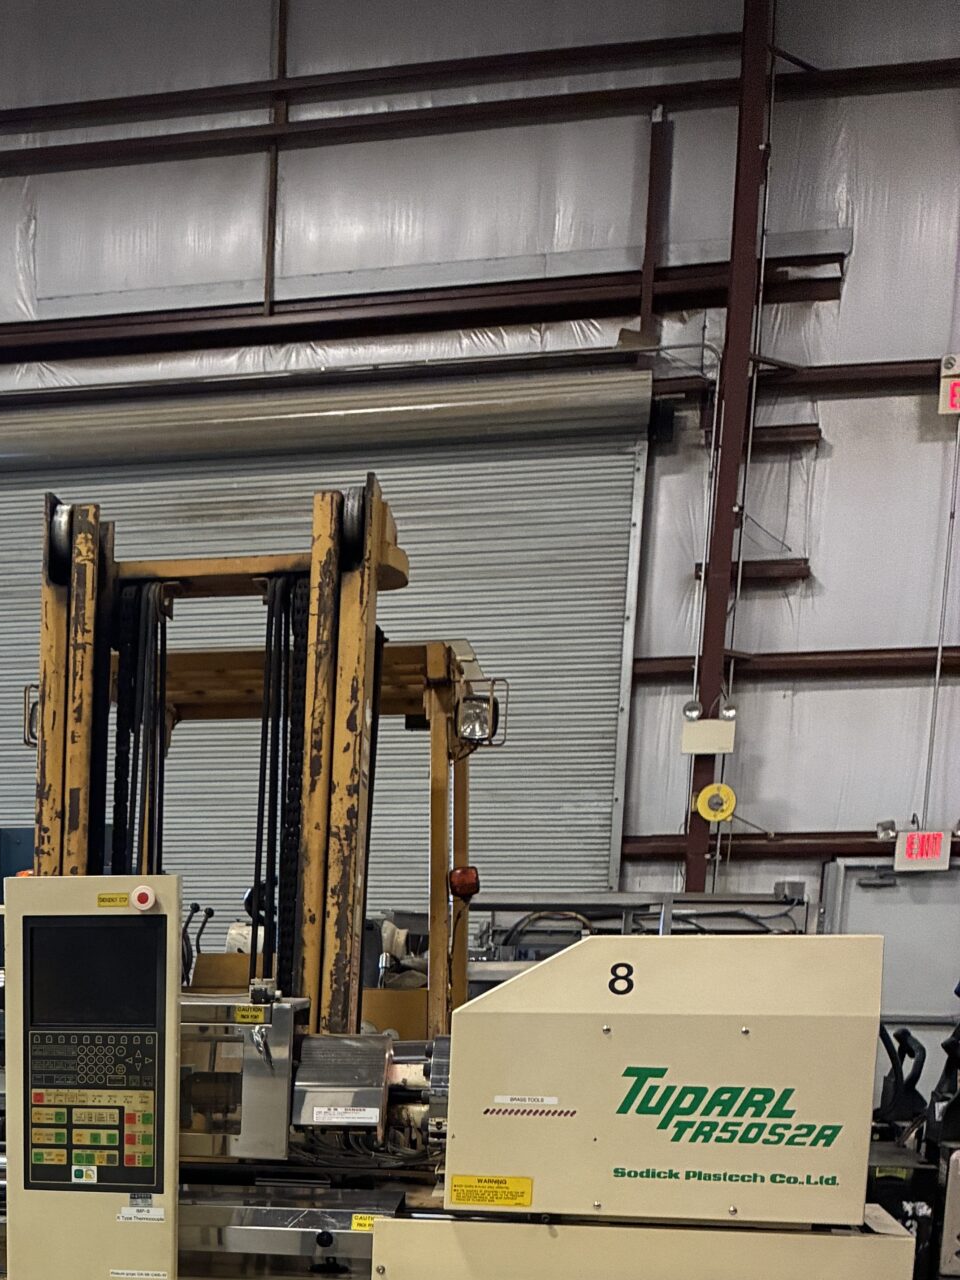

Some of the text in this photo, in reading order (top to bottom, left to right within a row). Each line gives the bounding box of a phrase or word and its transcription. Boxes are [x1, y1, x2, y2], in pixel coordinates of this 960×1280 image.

[905, 832, 943, 859] EXIT
[607, 962, 634, 995] 8
[613, 1167, 680, 1180] Sodick
[685, 1170, 765, 1183] Plastech
